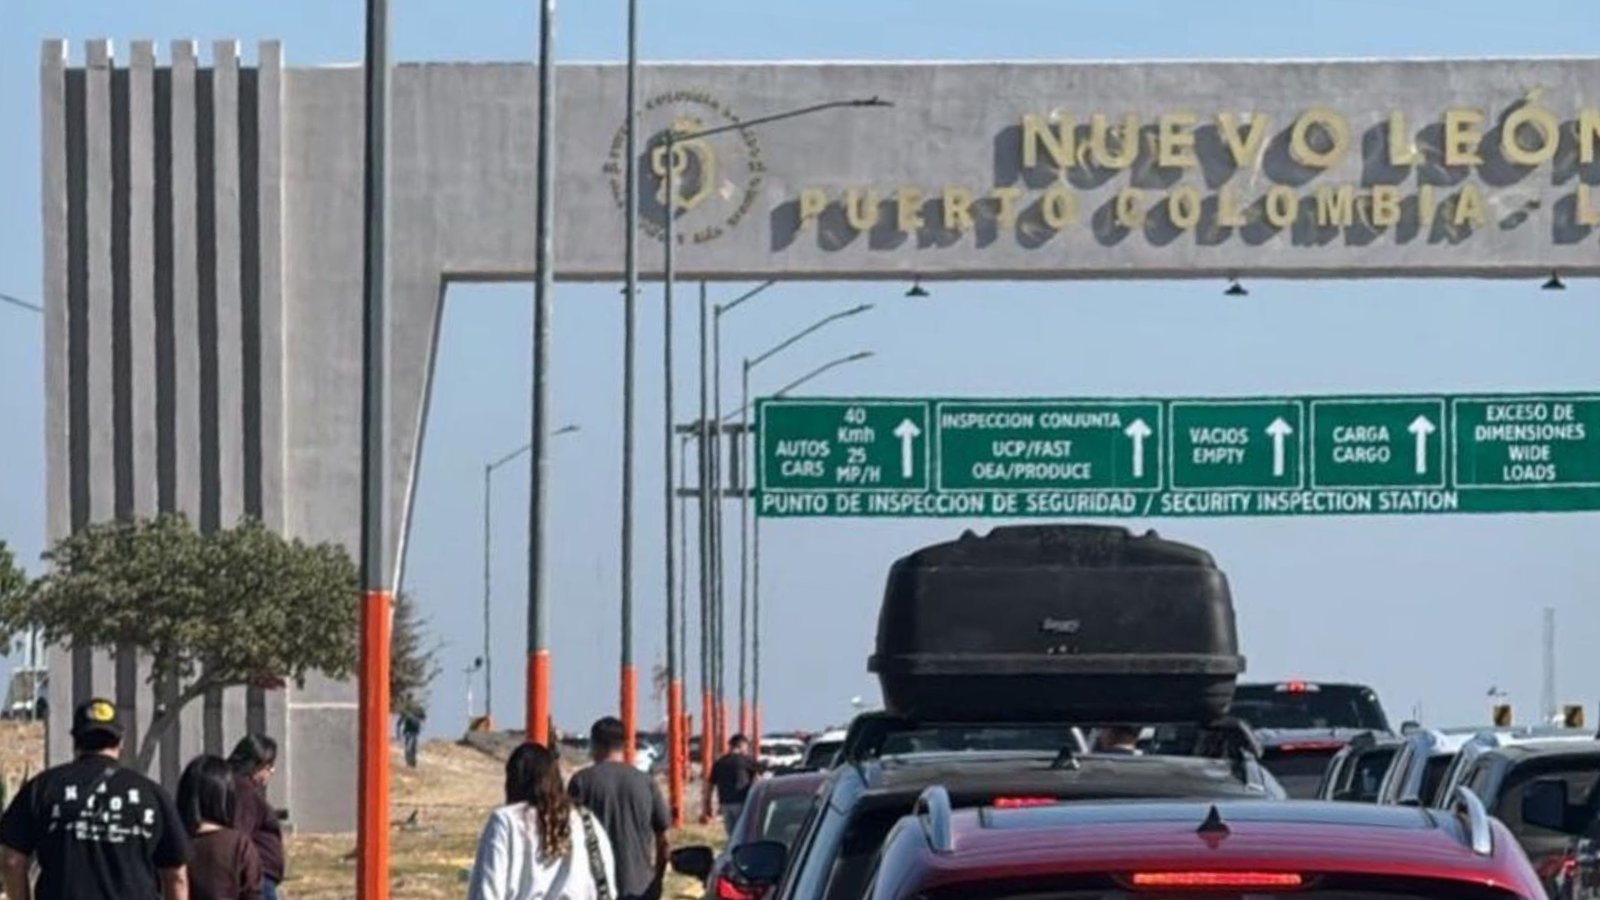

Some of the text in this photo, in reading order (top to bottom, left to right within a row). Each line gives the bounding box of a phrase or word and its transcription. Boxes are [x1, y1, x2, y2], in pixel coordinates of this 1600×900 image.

[1022, 108, 1350, 168] NUEVO
[800, 186, 1076, 232] PUERTO
[1116, 184, 1485, 229] COLOMBIA
[844, 407, 867, 424] 40
[942, 412, 1121, 429] INSPECCION CONJUNTA
[1486, 403, 1574, 421] EXCESO DE
[837, 426, 875, 443] Kmh
[1189, 427, 1249, 444] VACIOS
[1332, 426, 1390, 443] CARGA
[1475, 423, 1585, 441] DIMENSIONES
[775, 440, 831, 458] AUTOS
[847, 447, 867, 464] 25
[992, 440, 1072, 458] UCP/FAST
[1192, 447, 1245, 464] EMPTY
[1332, 446, 1391, 463] CARGO
[1508, 445, 1550, 461] WIDE
[781, 460, 825, 477] CARS
[836, 465, 881, 484] MP/H
[972, 462, 1092, 480] OEA/PRODUCE
[1503, 464, 1556, 481] LOADS
[762, 490, 1458, 516] PUNTO DE INSPECCION DE SEGURIDAD / SECURITY INSPECTION STATION
